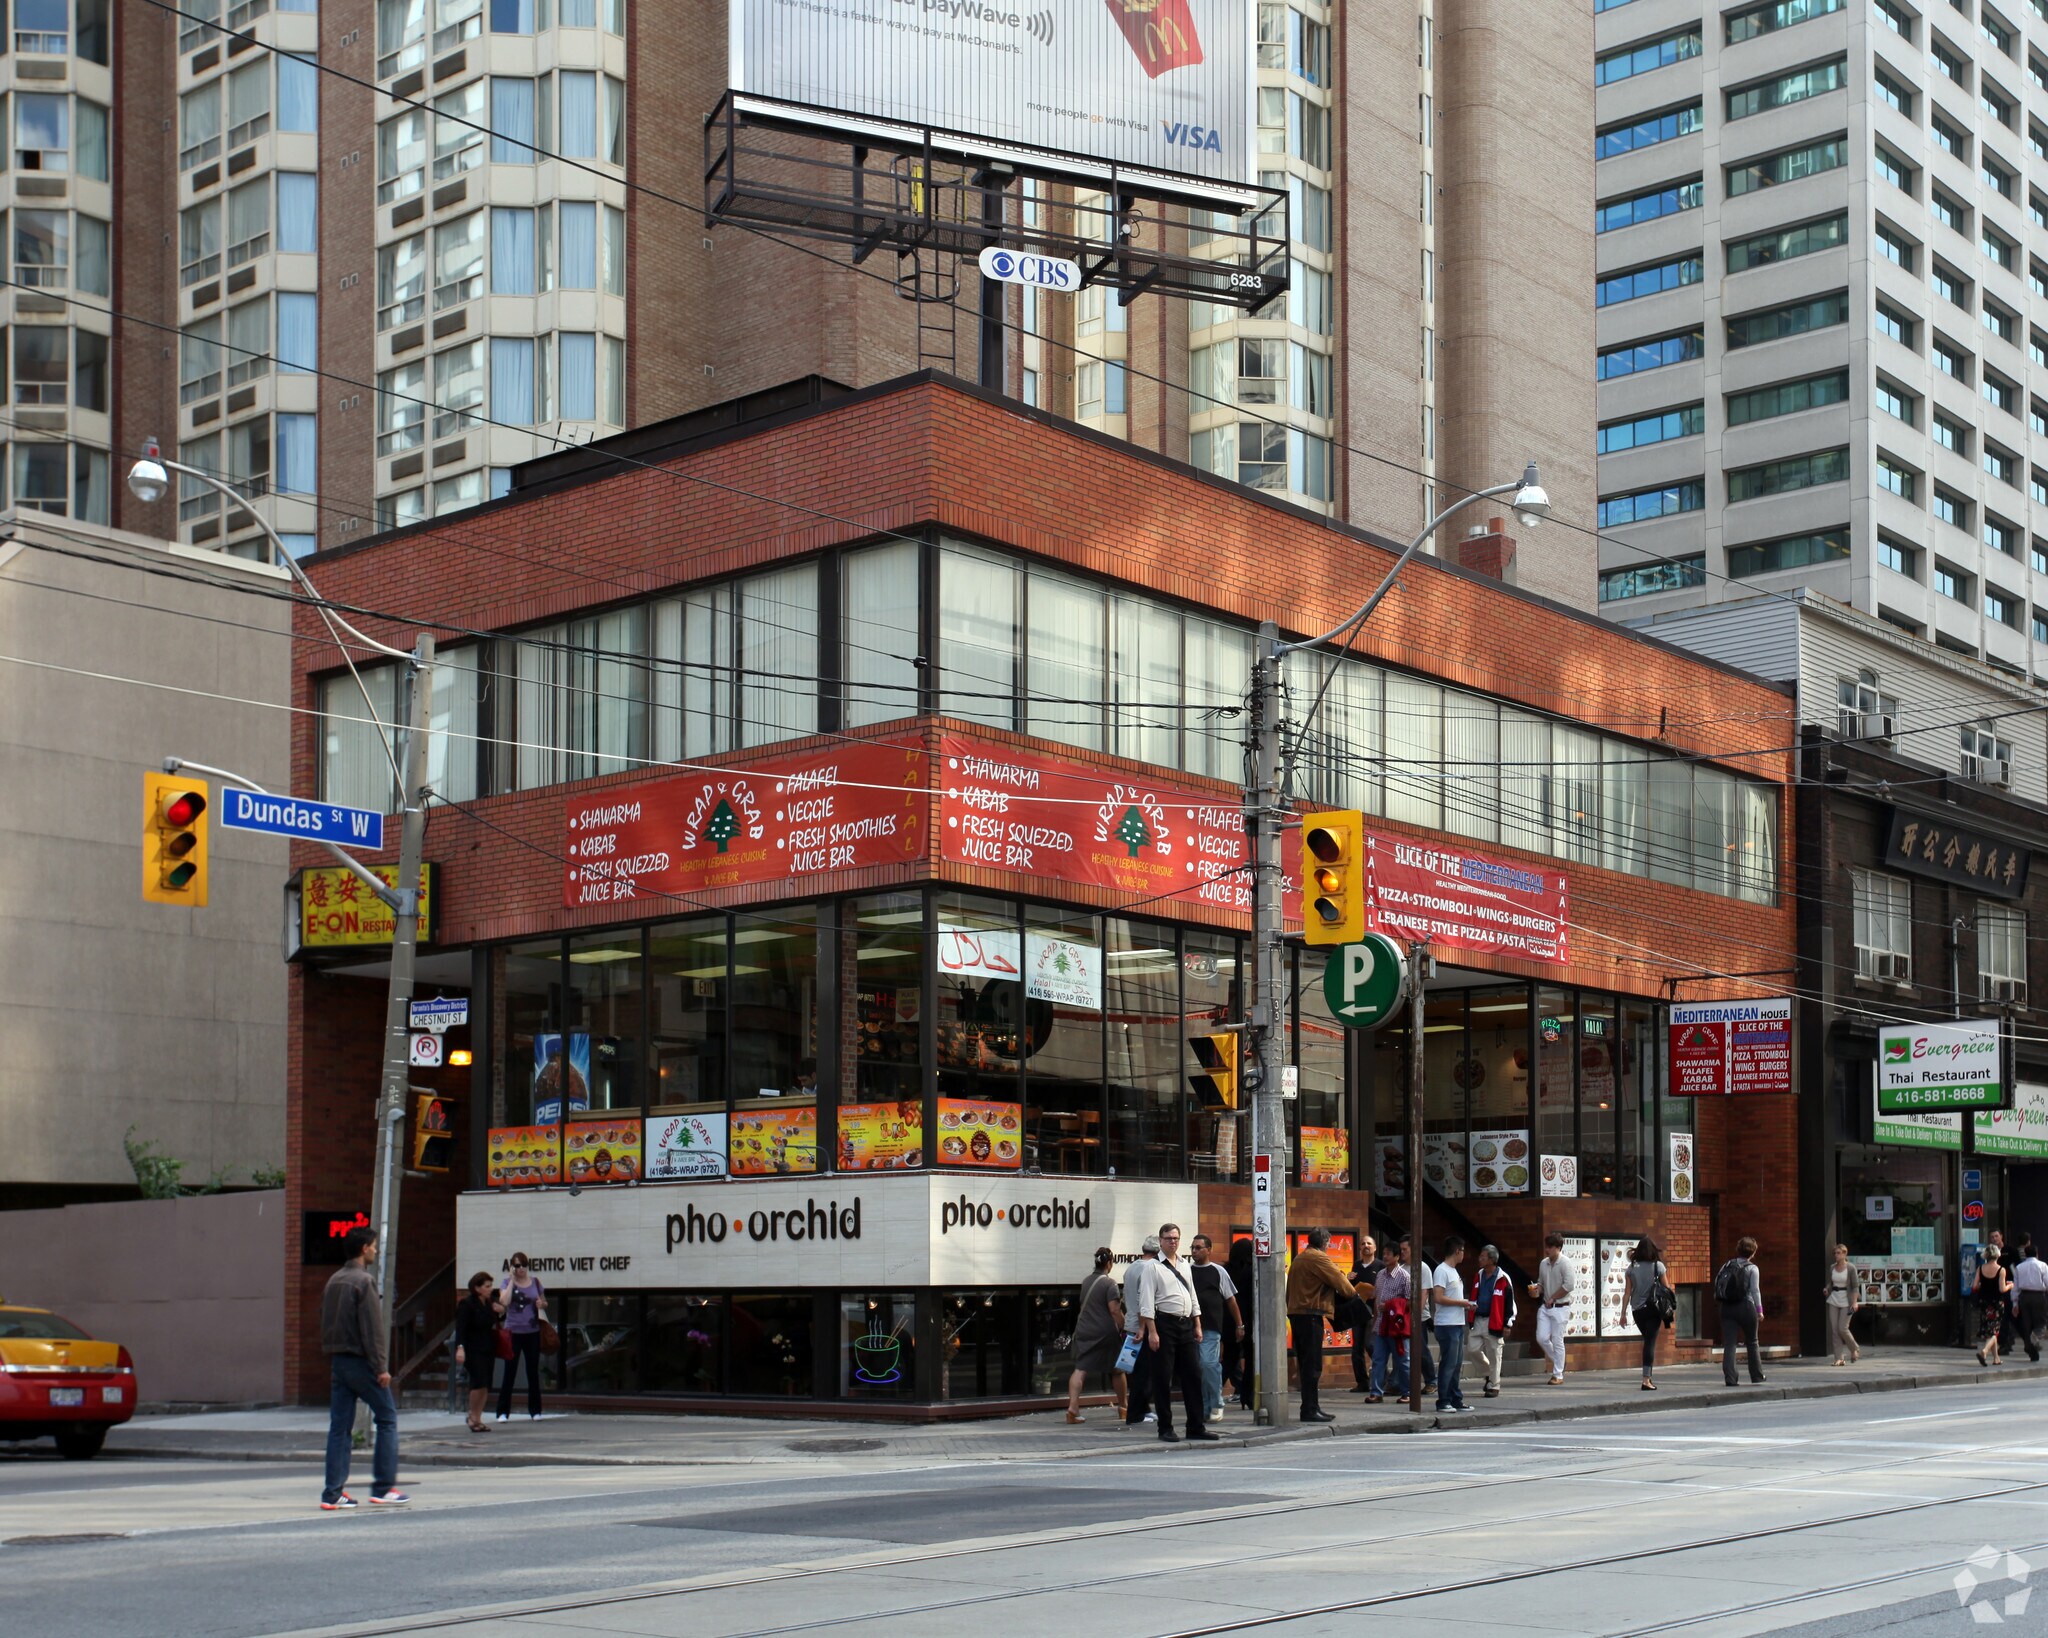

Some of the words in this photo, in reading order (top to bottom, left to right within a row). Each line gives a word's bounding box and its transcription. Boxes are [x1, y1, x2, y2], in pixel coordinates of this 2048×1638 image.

[842, 9, 848, 18] a
[851, 10, 883, 25] faster
[886, 19, 907, 32] way
[909, 23, 920, 33] to
[923, 27, 942, 39] pay
[944, 31, 955, 41] at
[922, 0, 1020, 28] payWave
[1027, 101, 1052, 114] more
[1054, 106, 1088, 120] people
[1091, 114, 1103, 124] go
[1105, 115, 1126, 127] with
[1128, 119, 1148, 132] Visa
[1159, 119, 1223, 153] VISA
[1019, 255, 1069, 287] CBS
[1230, 272, 1262, 288] 6283
[786, 765, 838, 795] FALAFEL
[962, 755, 1041, 790] SHAWARMA
[787, 796, 834, 823] VEGGIE
[962, 785, 1010, 814] KABAB
[237, 793, 323, 832] Dundas
[331, 808, 343, 824] St
[351, 812, 370, 838] W
[580, 801, 641, 831] SHAWARMA
[682, 784, 713, 850] WRAP
[717, 782, 728, 794] &
[732, 780, 764, 840] GRAB
[1093, 784, 1124, 842] WRAP
[1128, 786, 1139, 799] &
[1142, 793, 1172, 856] GRAB
[1198, 807, 1245, 832] FALAFEL
[580, 834, 616, 856] KABAB
[788, 826, 826, 851] FRESH
[829, 814, 897, 846] SMOOTHIES
[962, 814, 1004, 840] FRESH
[1008, 823, 1073, 852] SQUEZZED
[962, 837, 1002, 862] JUICE
[1005, 847, 1034, 869] BAR
[1198, 832, 1240, 859] VEGGIE
[580, 862, 613, 883] FRESH
[615, 852, 670, 878] SQUEZZED
[790, 849, 827, 873] JUICE
[829, 845, 855, 868] BAR
[1197, 859, 1233, 883] FRESH
[1394, 843, 1423, 869] SLICE
[1424, 850, 1439, 872] OF
[1440, 853, 1461, 877] THE
[1462, 858, 1544, 895] MEDITERRANEAN
[580, 883, 610, 904] JUICE
[613, 879, 636, 900] BAR
[1199, 881, 1233, 903] JUICE
[307, 911, 359, 934] E-ON
[1378, 886, 1409, 904] PIZZA
[1413, 894, 1473, 917] STROMBOLI
[1475, 906, 1510, 924] WINGS
[1512, 913, 1556, 934] BURGERS
[1377, 910, 1428, 931] LEBANESE
[1431, 920, 1459, 937] STYLE
[1460, 926, 1488, 943] PIZZA
[1488, 931, 1495, 943] &
[1496, 932, 1526, 950] PASTA
[940, 927, 1019, 975] حلال
[1343, 944, 1375, 1002] P
[413, 1013, 451, 1026] CHESTNUT
[1541, 1018, 1561, 1033] PIZZA
[1674, 1007, 1758, 1024] MEDITERRANEAN
[1760, 1009, 1788, 1020] HOUSE
[1738, 1022, 1757, 1032] SLICE
[1758, 1022, 1768, 1031] OF
[1769, 1021, 1783, 1030] THE
[1677, 1026, 1694, 1047] WRAP
[1912, 1037, 1995, 1061] Evergreen
[1676, 1058, 1721, 1067] SHAWARMA
[1733, 1051, 1751, 1061] PIZZA
[1754, 1050, 1790, 1060] STROMBOLI
[1735, 1062, 1756, 1072] WINGS
[1759, 1060, 1788, 1071] BURGERS
[1682, 1067, 1714, 1075] FALAFEL
[1733, 1073, 1758, 1081] LEBANESE
[1759, 1072, 1773, 1080] STYLE
[1774, 1071, 1789, 1079] PIZZA
[1889, 1072, 1914, 1085] Thai
[1922, 1067, 1991, 1083] Restaurant
[1679, 1084, 1700, 1092] JUICE
[1701, 1083, 1717, 1091] BAR
[1737, 1083, 1750, 1091] PASTA
[1895, 1087, 1985, 1104] 416-581-8668
[1921, 1115, 1953, 1127] Restaurant
[1916, 1129, 1933, 1144] Delivery
[1975, 1135, 1987, 1146] Dine
[1987, 1136, 1992, 1146] In
[1992, 1137, 1997, 1147] &
[1998, 1138, 2009, 1149] Take
[2009, 1139, 2018, 1149] Out
[2019, 1140, 2023, 1150] &
[2023, 1140, 2042, 1154] Delivery
[664, 1165, 699, 1176] 95-WRAP
[942, 1194, 993, 1234] pho
[1009, 1197, 1090, 1229] orchid
[1963, 1204, 1984, 1218] OPEN
[666, 1203, 727, 1254] pho
[748, 1197, 861, 1242] orchid
[502, 1257, 565, 1272] AHENTIC
[570, 1257, 595, 1271] VIET
[600, 1256, 631, 1271] CHEF
